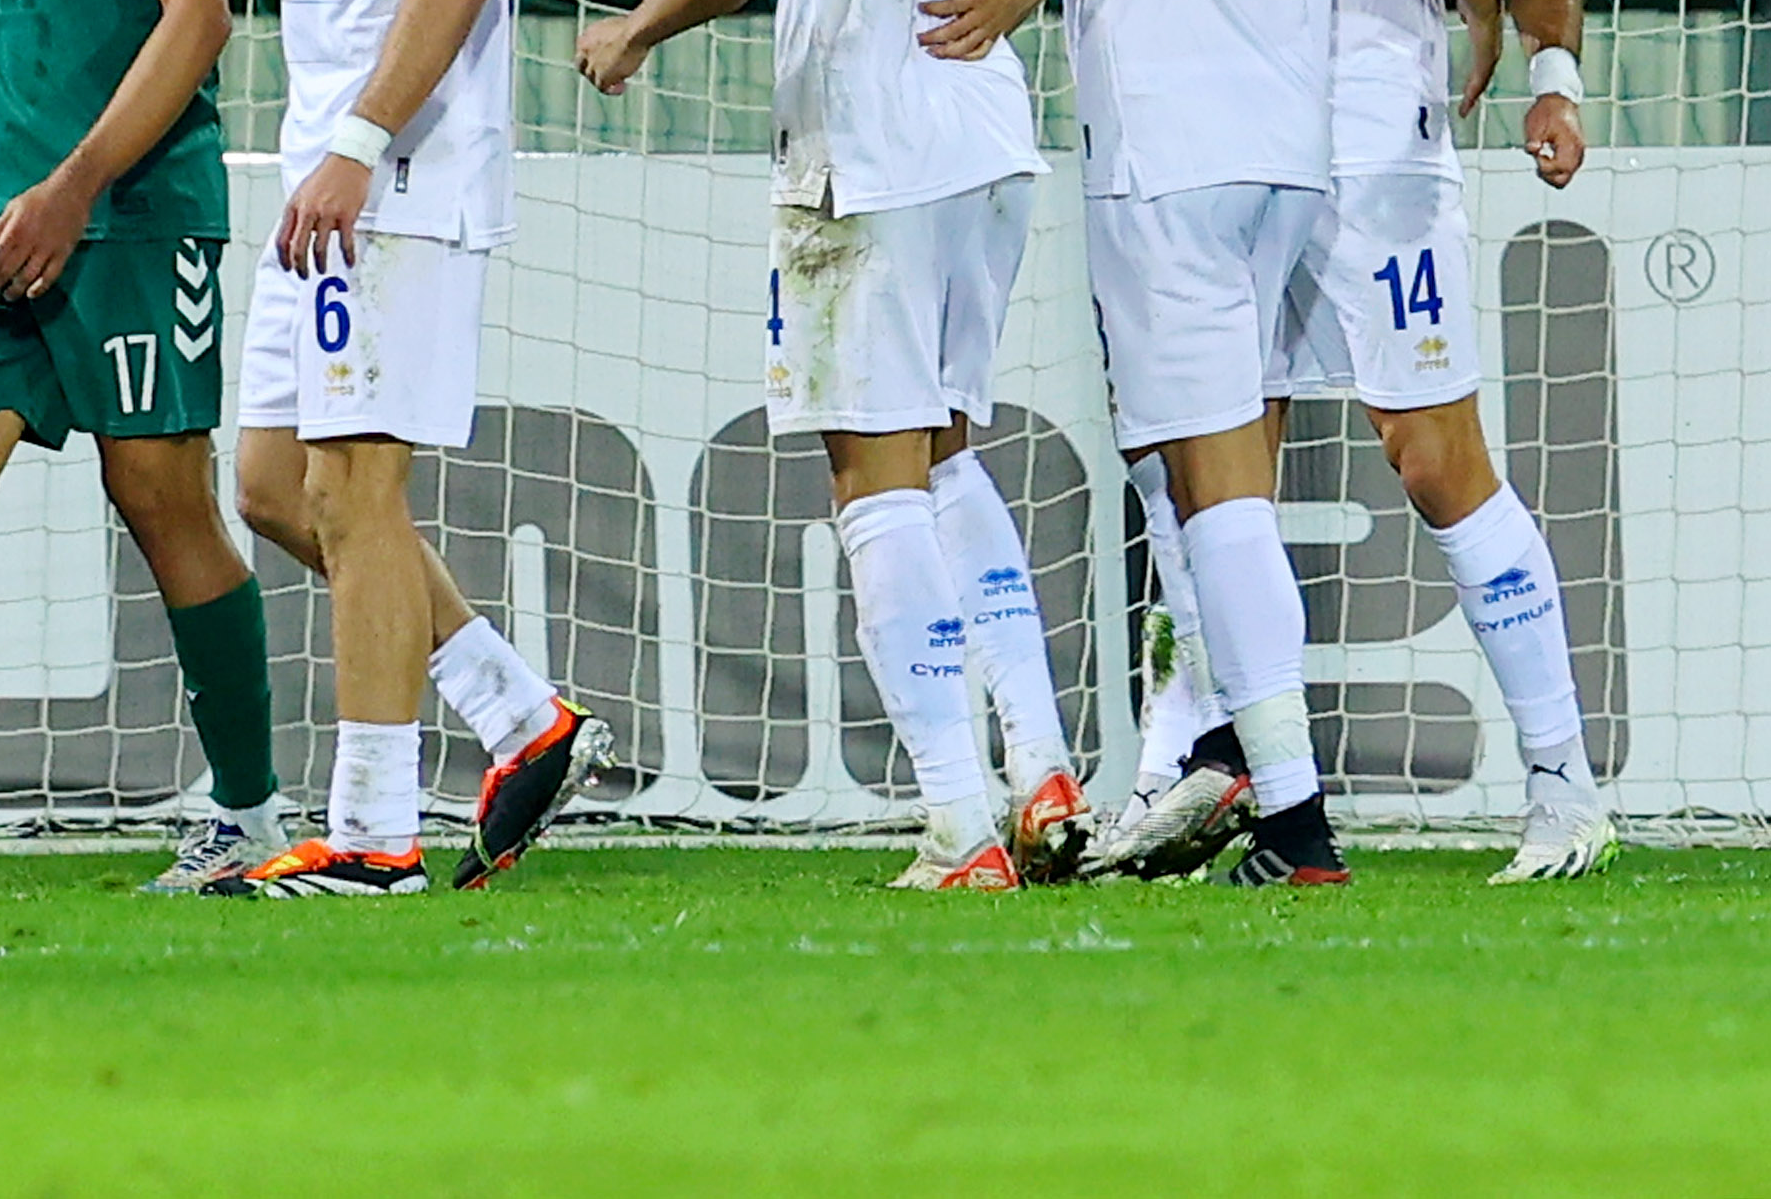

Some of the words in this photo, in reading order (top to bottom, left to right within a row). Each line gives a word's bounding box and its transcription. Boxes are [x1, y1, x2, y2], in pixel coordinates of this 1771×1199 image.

[315, 276, 351, 353] 6
[1373, 248, 1443, 330] 14
[103, 334, 156, 414] 17
[1474, 598, 1555, 633] CYPRUS
